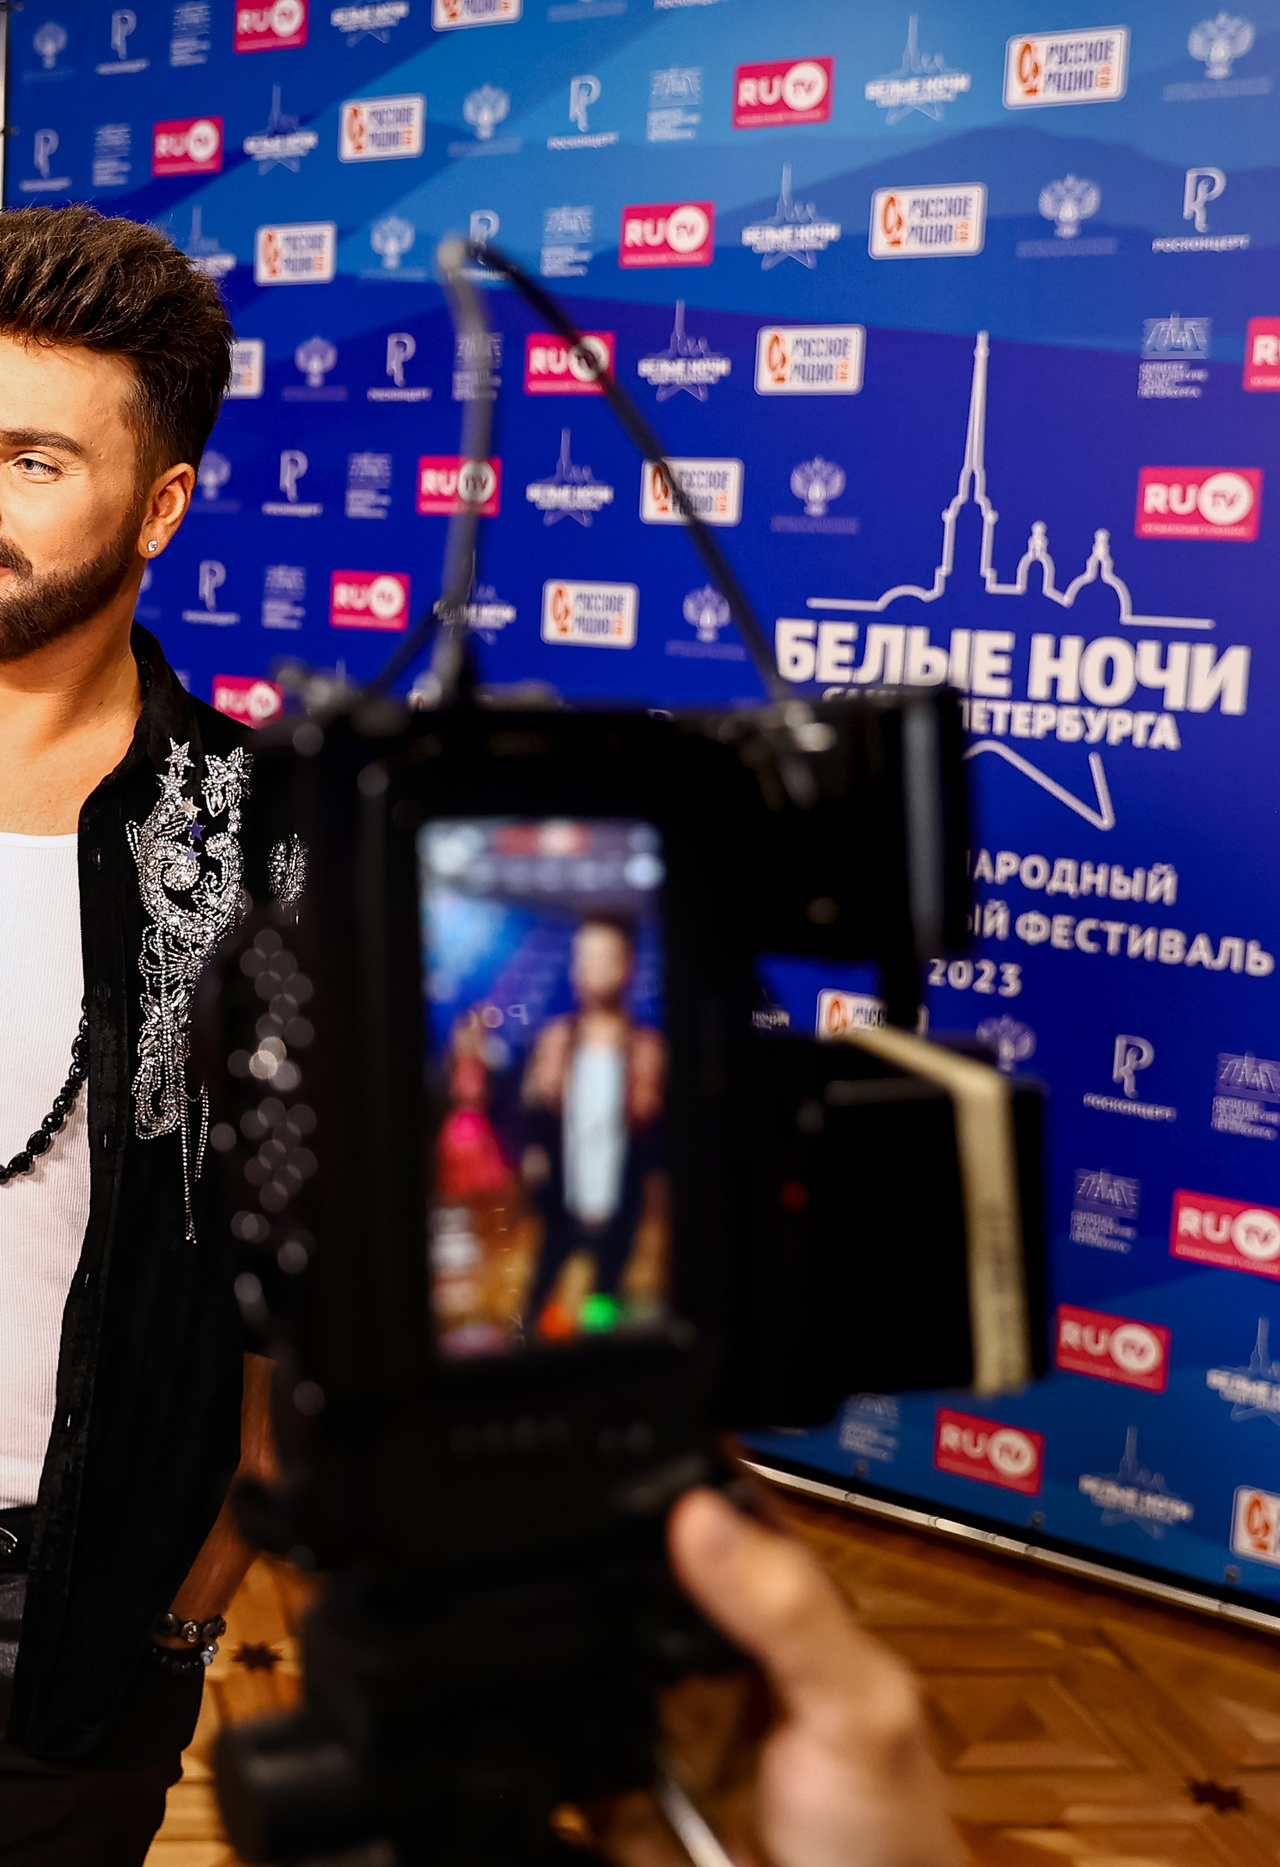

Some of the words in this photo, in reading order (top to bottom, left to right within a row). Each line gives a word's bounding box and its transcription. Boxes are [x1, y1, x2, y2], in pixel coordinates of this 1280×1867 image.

[775, 617, 1015, 698] БЕЛЫЕ
[1028, 634, 1252, 715] НОЧИ
[967, 848, 1178, 905] АРОДНЫЙ
[1015, 910, 1275, 977] ФЕСТИВАЛЬ
[927, 958, 1022, 998] 2023
